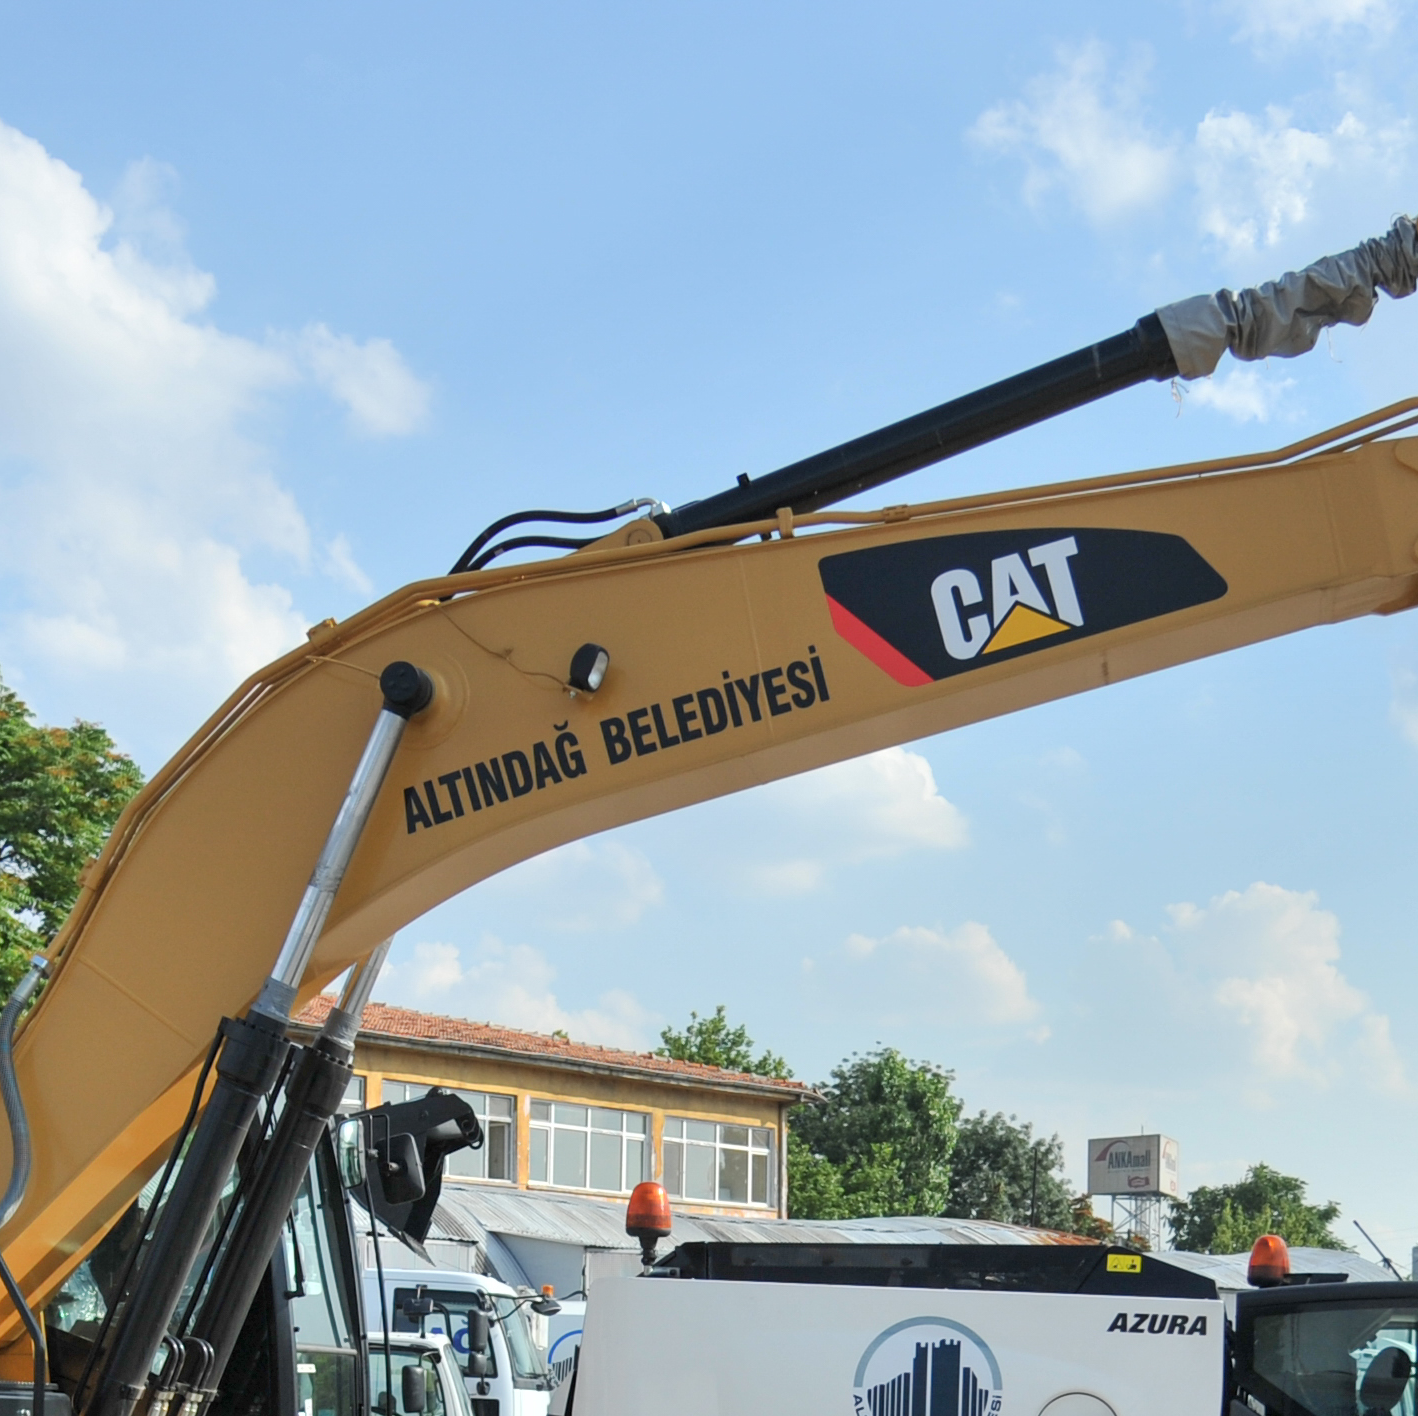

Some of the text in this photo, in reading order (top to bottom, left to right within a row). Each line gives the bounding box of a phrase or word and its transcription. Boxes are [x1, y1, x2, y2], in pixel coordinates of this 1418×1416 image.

[929, 535, 1085, 661] CAT
[403, 644, 831, 835] ALTINDAĞ BELEDİYESİ
[1107, 1312, 1208, 1336] AZURA
